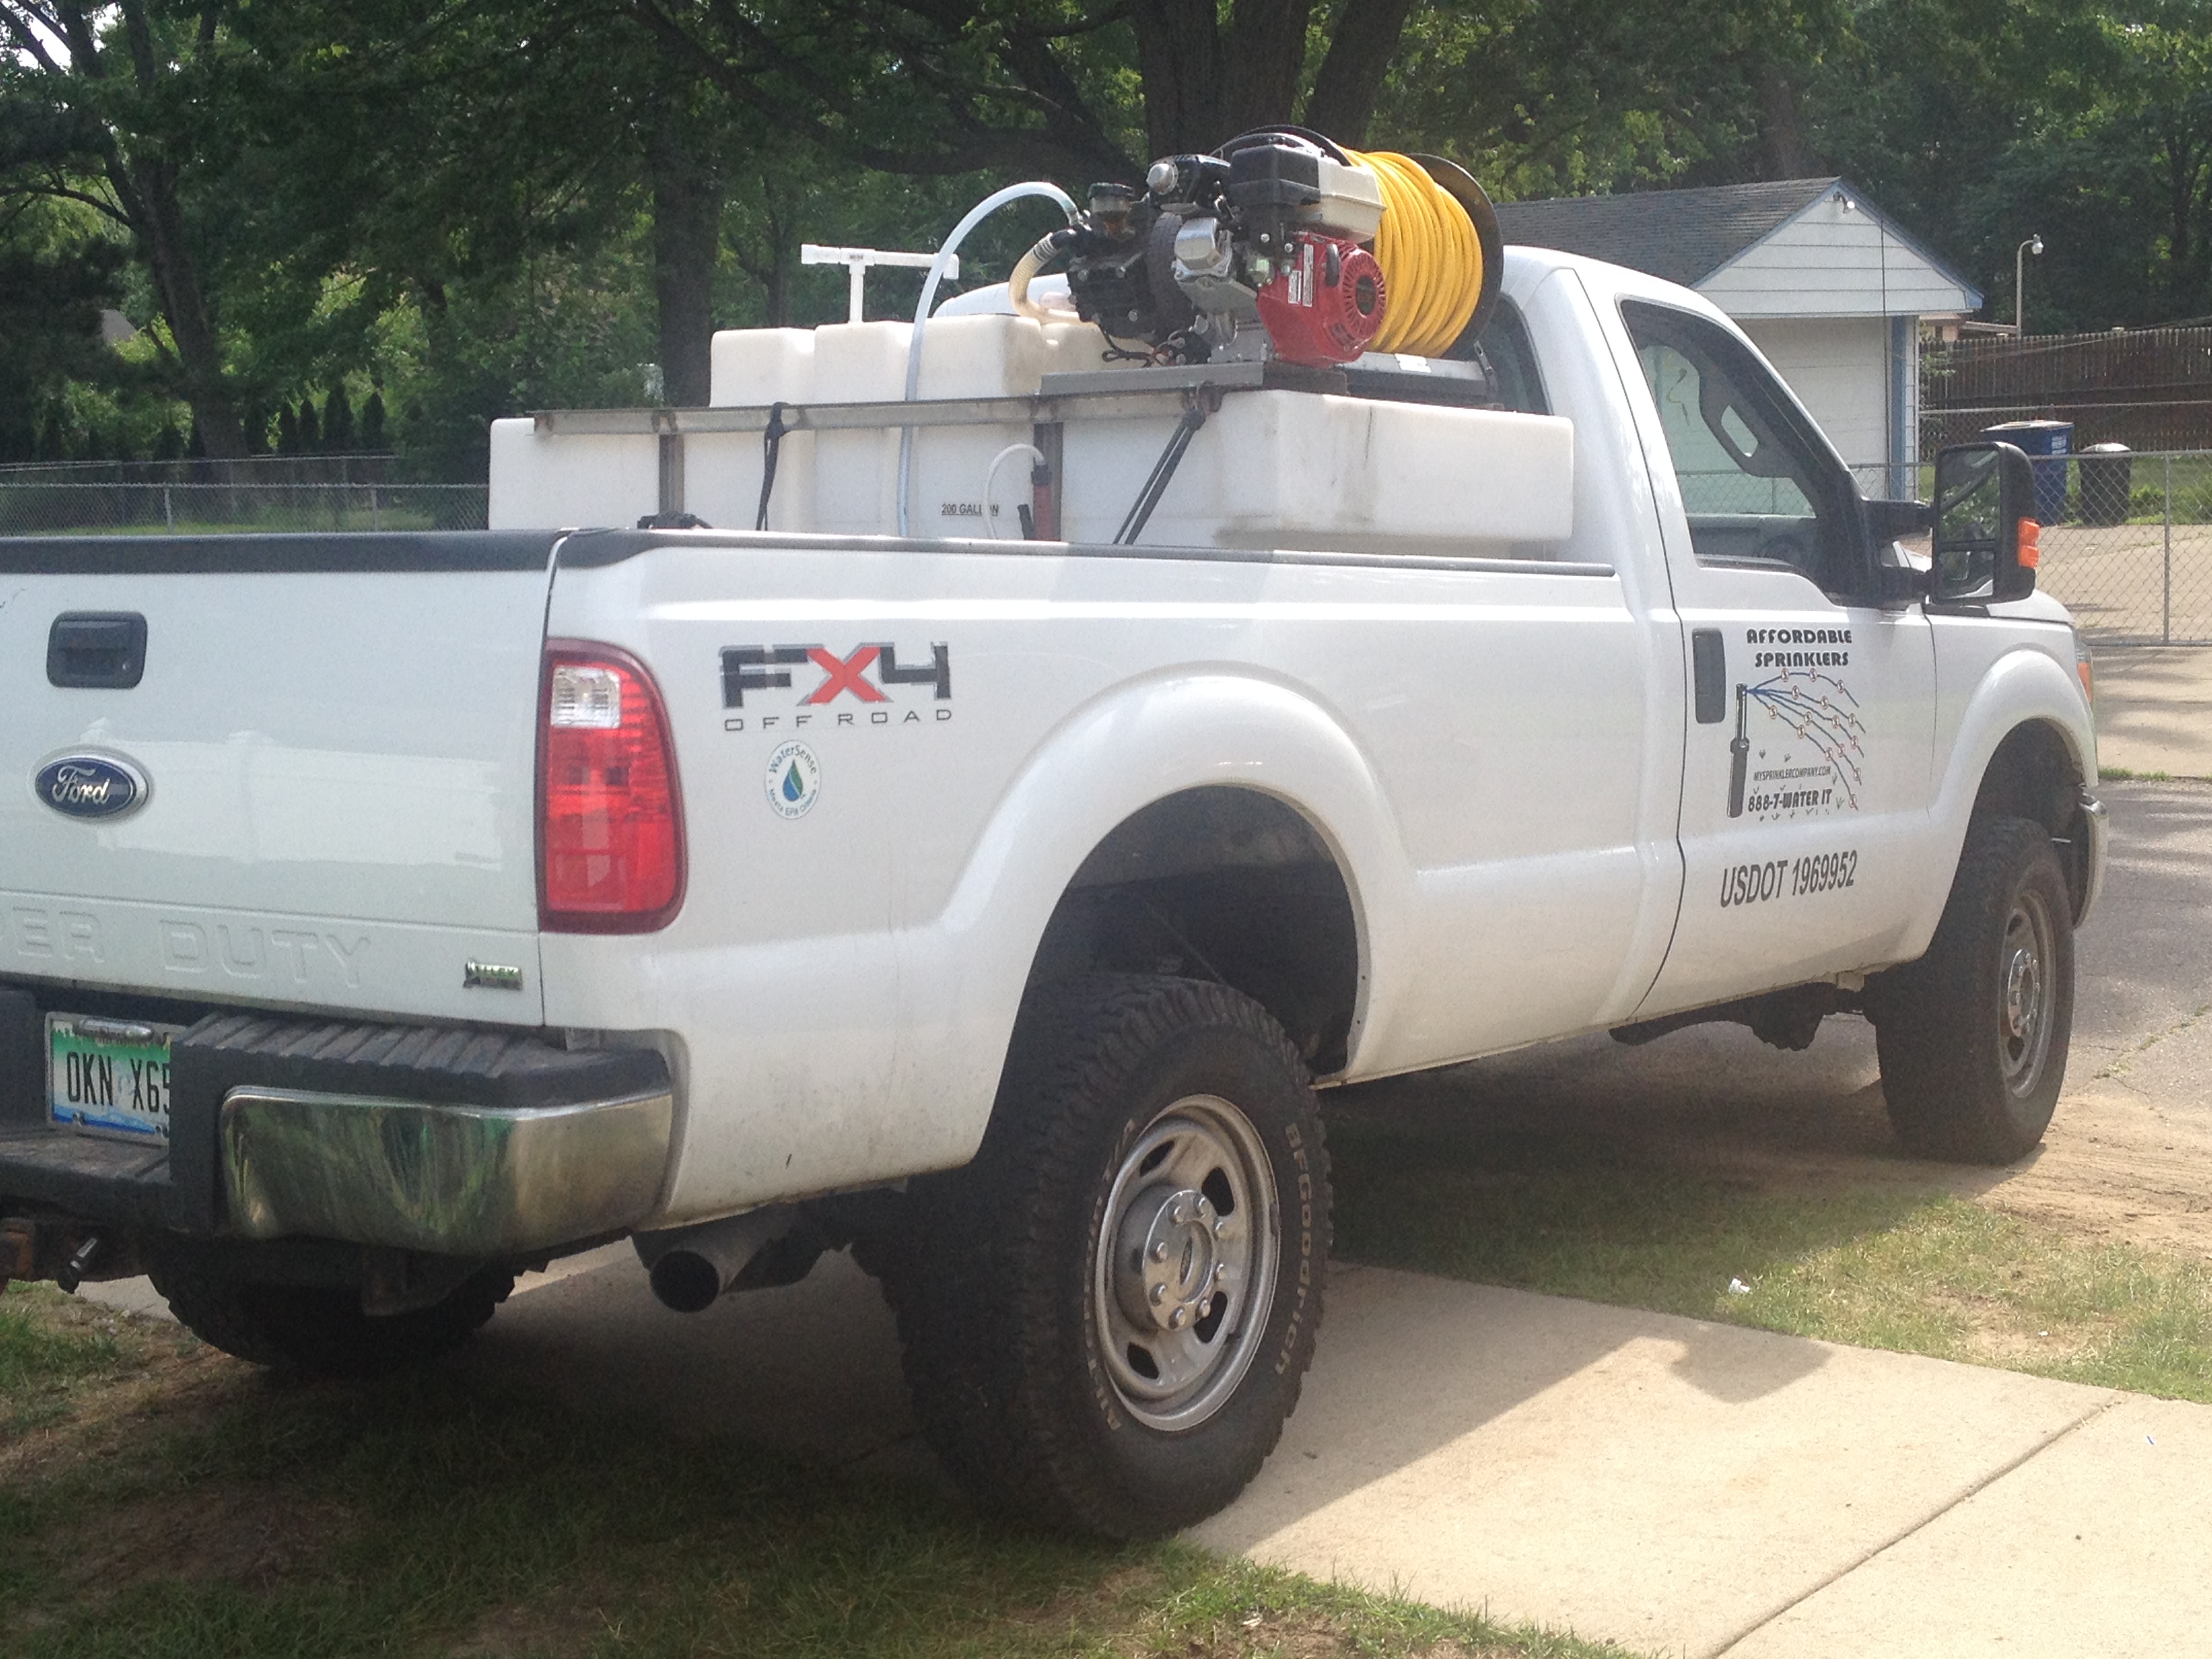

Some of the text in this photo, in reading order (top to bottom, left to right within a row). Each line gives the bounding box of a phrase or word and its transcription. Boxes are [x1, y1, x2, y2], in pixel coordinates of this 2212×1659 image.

[941, 503, 1000, 515] 200 GALLN
[1746, 628, 1852, 644] AFFORDABLE
[719, 641, 952, 710] FX4
[1755, 651, 1849, 668] SPRINKLERS
[52, 765, 110, 805] Ford
[1748, 788, 1832, 812] 888-7-WATER IT
[1720, 849, 1858, 908] USDOT 1969952
[2, 905, 372, 989] ER DUTY
